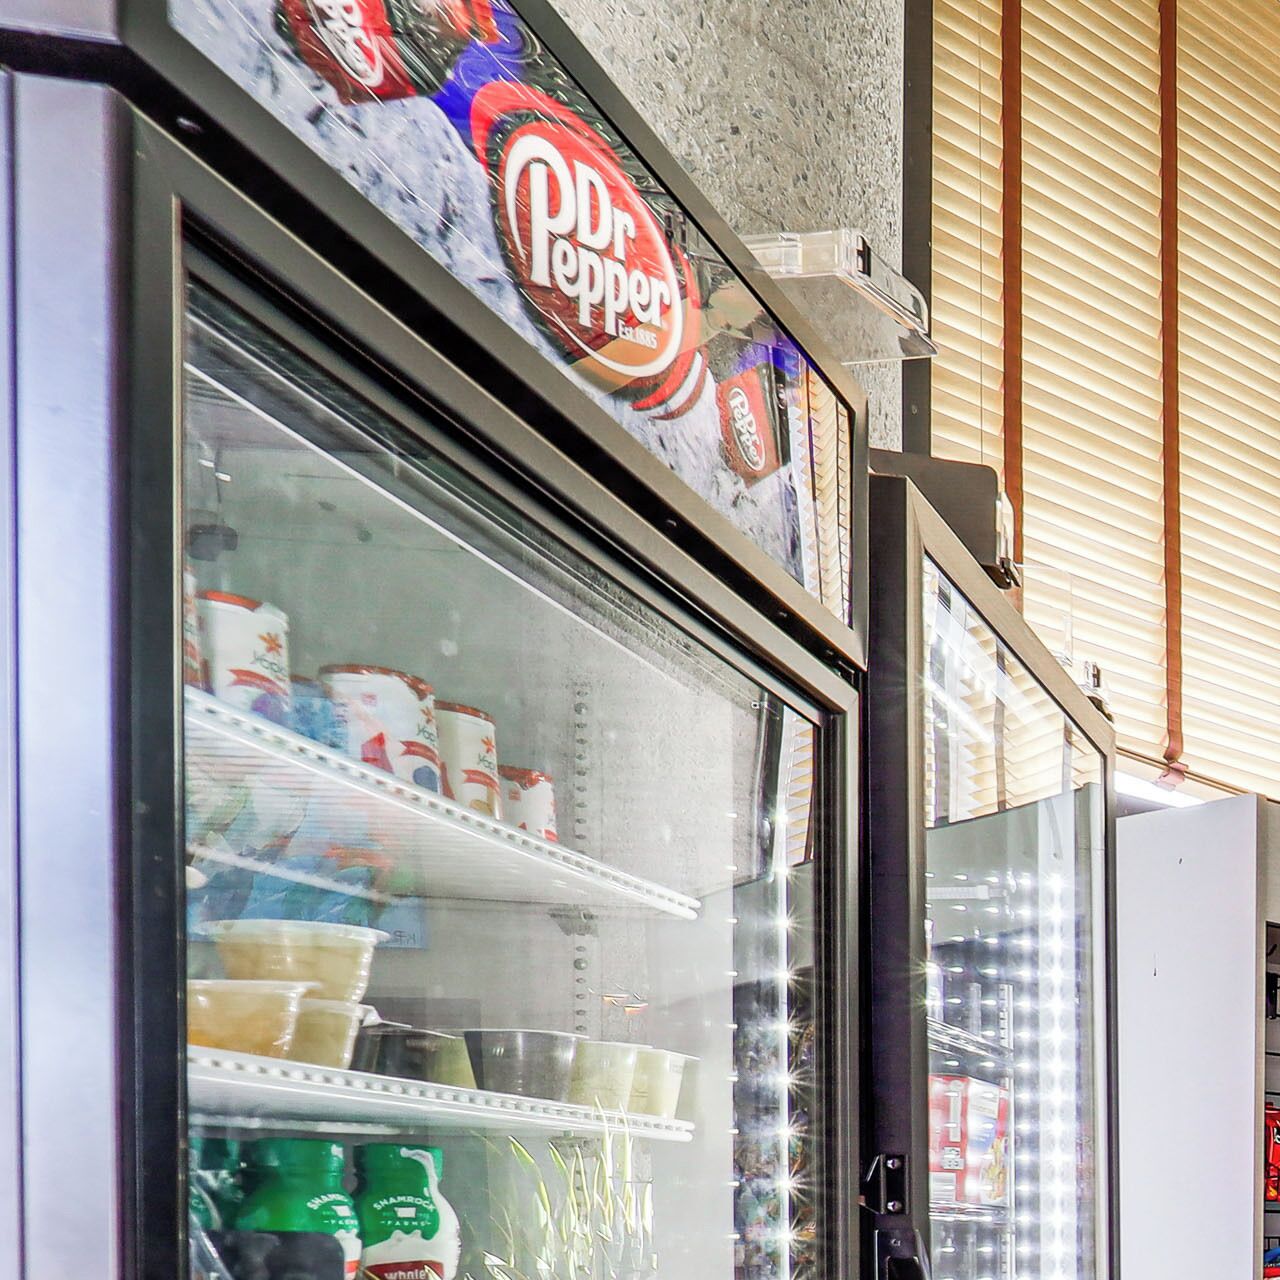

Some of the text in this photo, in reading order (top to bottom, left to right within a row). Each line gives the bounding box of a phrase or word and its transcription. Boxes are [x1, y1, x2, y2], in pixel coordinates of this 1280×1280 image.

[505, 134, 671, 337] Pepper
[573, 159, 637, 262] Dr
[373, 1194, 437, 1214] SHAMROCK
[384, 1268, 427, 1280] whole
